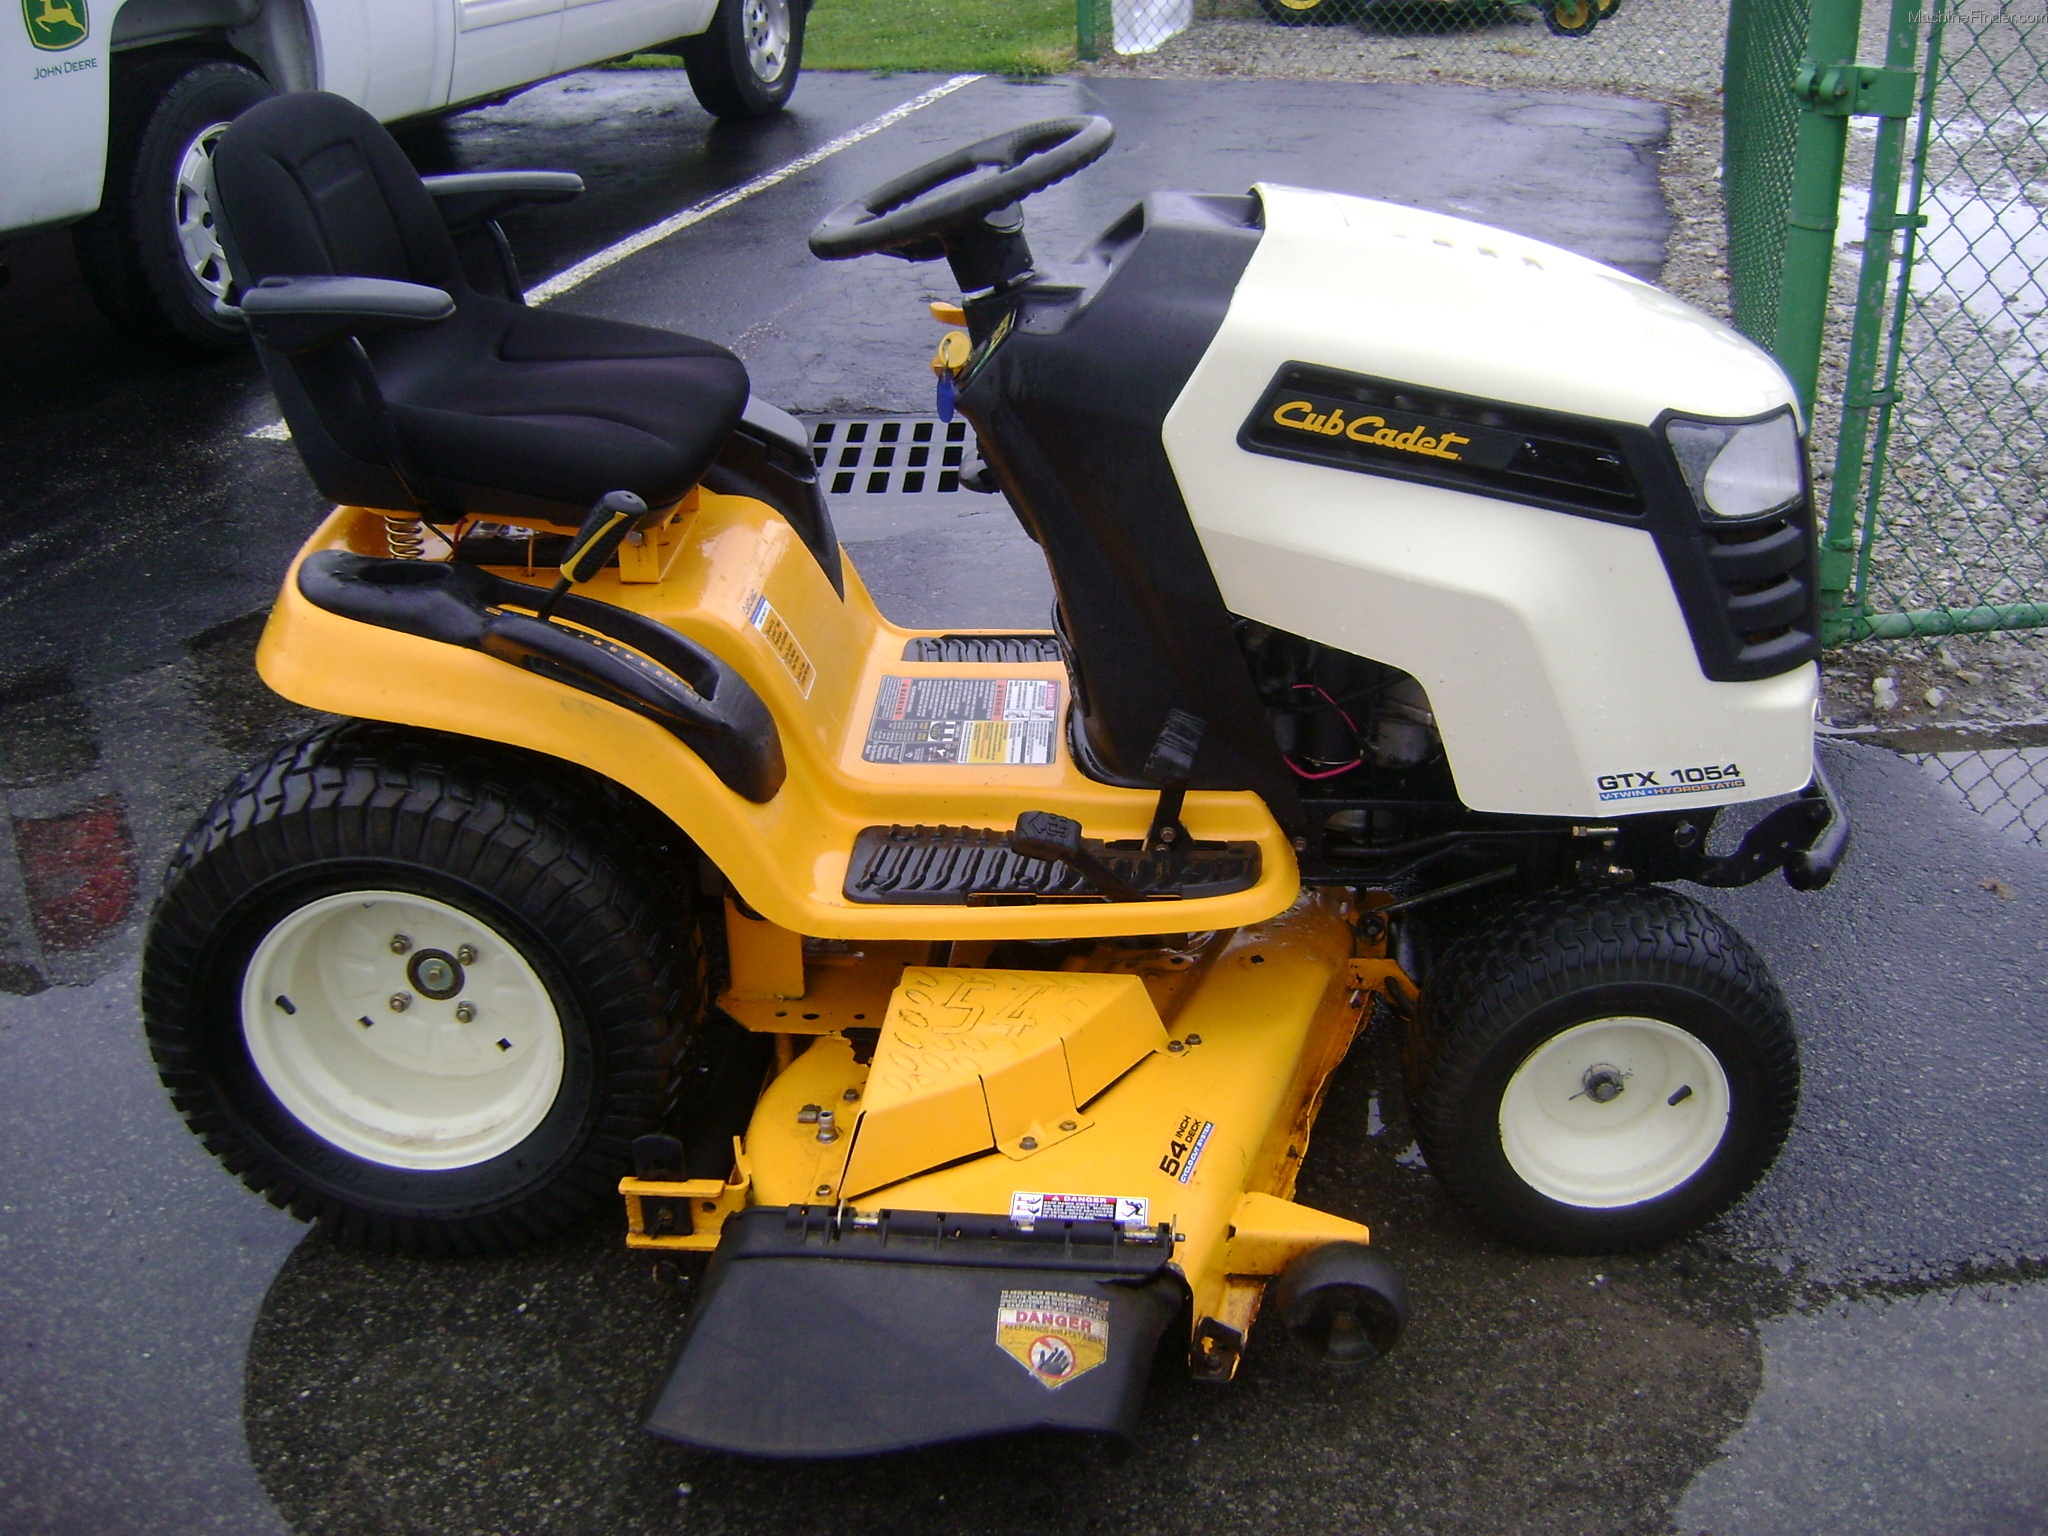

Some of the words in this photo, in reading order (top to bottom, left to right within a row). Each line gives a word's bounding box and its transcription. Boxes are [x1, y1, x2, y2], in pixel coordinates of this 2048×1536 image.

[33, 66, 63, 80] JOHN
[63, 58, 98, 74] DEERE
[1272, 399, 1344, 435] Cub
[1344, 416, 1470, 461] Cadet
[895, 689, 908, 715] WARNING
[994, 690, 1004, 716] WARNING
[1597, 770, 1660, 791] GTX
[1670, 763, 1741, 783] 1054
[1653, 780, 1744, 795] HYDROSTATIC
[930, 980, 1045, 1038] 54
[1184, 1119, 1202, 1144] DECK
[1196, 1122, 1212, 1147] SYSTEM
[1158, 1139, 1189, 1177] 54
[1175, 1115, 1192, 1139] INCH
[1063, 1196, 1107, 1204] DANGER
[1004, 1324, 1024, 1332] KEEP
[1024, 1325, 1049, 1333] HANDS
[1050, 1327, 1063, 1335] and
[1064, 1329, 1081, 1339] FEET
[1016, 1310, 1092, 1333] DANGER
